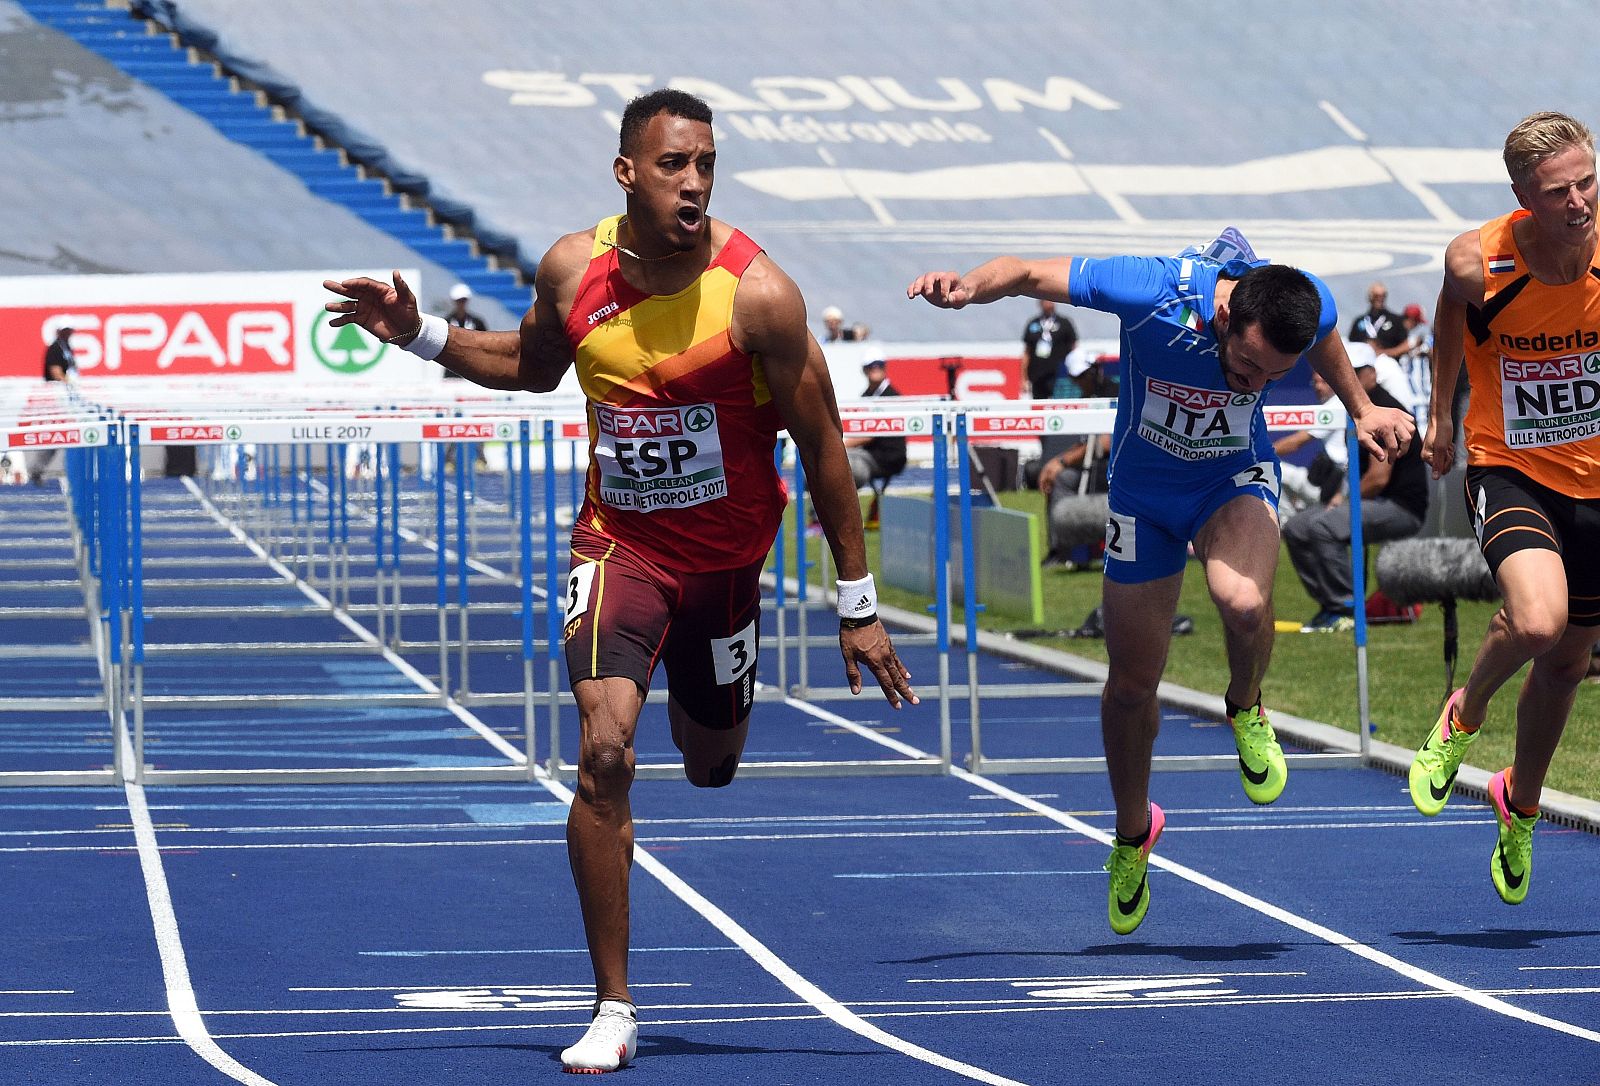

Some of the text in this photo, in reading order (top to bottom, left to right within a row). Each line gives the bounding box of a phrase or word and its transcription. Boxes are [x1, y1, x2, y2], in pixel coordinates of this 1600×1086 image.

[482, 70, 1121, 112] STADIUM
[728, 115, 994, 146] Métropole
[41, 311, 292, 370] SPAR
[1504, 360, 1580, 378] SPAR
[1150, 381, 1228, 407] SPAR
[1515, 380, 1600, 416] NED
[599, 409, 680, 434] SPAR
[848, 419, 904, 431] SPAR
[987, 418, 1046, 431] SPAR
[1164, 402, 1231, 438] ITA
[1265, 411, 1315, 425] SPAR
[1539, 419, 1559, 428] RUN
[1561, 413, 1592, 425] CLEAN
[23, 431, 80, 444] SPAR
[165, 427, 223, 440] SPAR
[292, 426, 372, 439] LILLE 2017
[437, 424, 494, 438] SPAR
[1191, 438, 1222, 448] CLEAN
[1509, 432, 1534, 446] LILLE
[1536, 423, 1596, 444] METROPOLE
[1140, 427, 1163, 445] LILLE
[1163, 440, 1226, 461] METROPOLE
[615, 440, 698, 479] ESP
[658, 476, 695, 488] CLEAN
[1244, 467, 1268, 484] 2
[604, 480, 725, 509] LILLE METROPOLE 2017
[1109, 517, 1122, 554] 2
[567, 576, 579, 615] 3
[728, 640, 748, 675] 3
